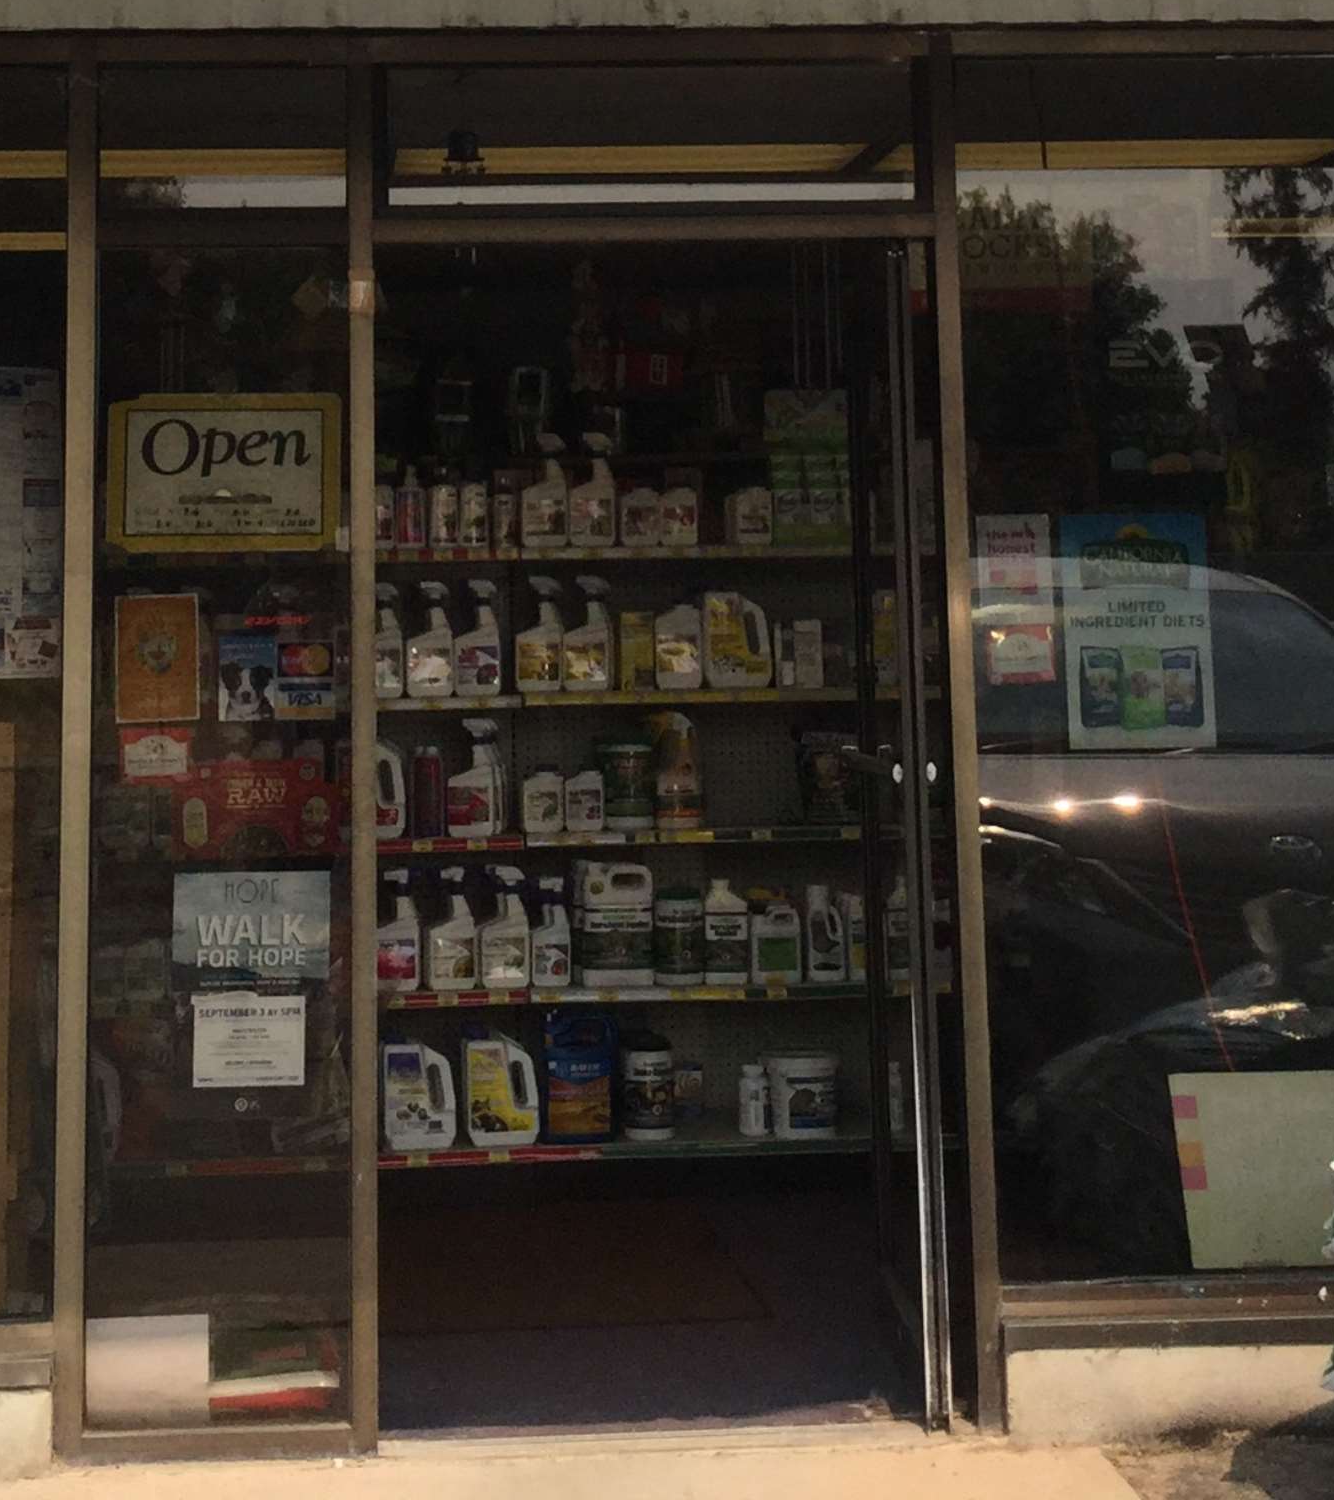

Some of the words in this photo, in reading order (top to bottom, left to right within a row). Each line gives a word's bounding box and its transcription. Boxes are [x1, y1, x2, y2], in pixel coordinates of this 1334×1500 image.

[140, 418, 313, 477] Open
[1107, 600, 1166, 613] LIMITED
[1069, 614, 1158, 629] INGREDIENT
[1162, 613, 1205, 628] DIETS
[287, 690, 323, 707] VISA
[227, 787, 287, 805] RAW
[196, 913, 307, 947] WALK
[196, 948, 240, 969] FOR
[247, 947, 308, 967] HOPE
[198, 1007, 258, 1018] SEPTEMBER
